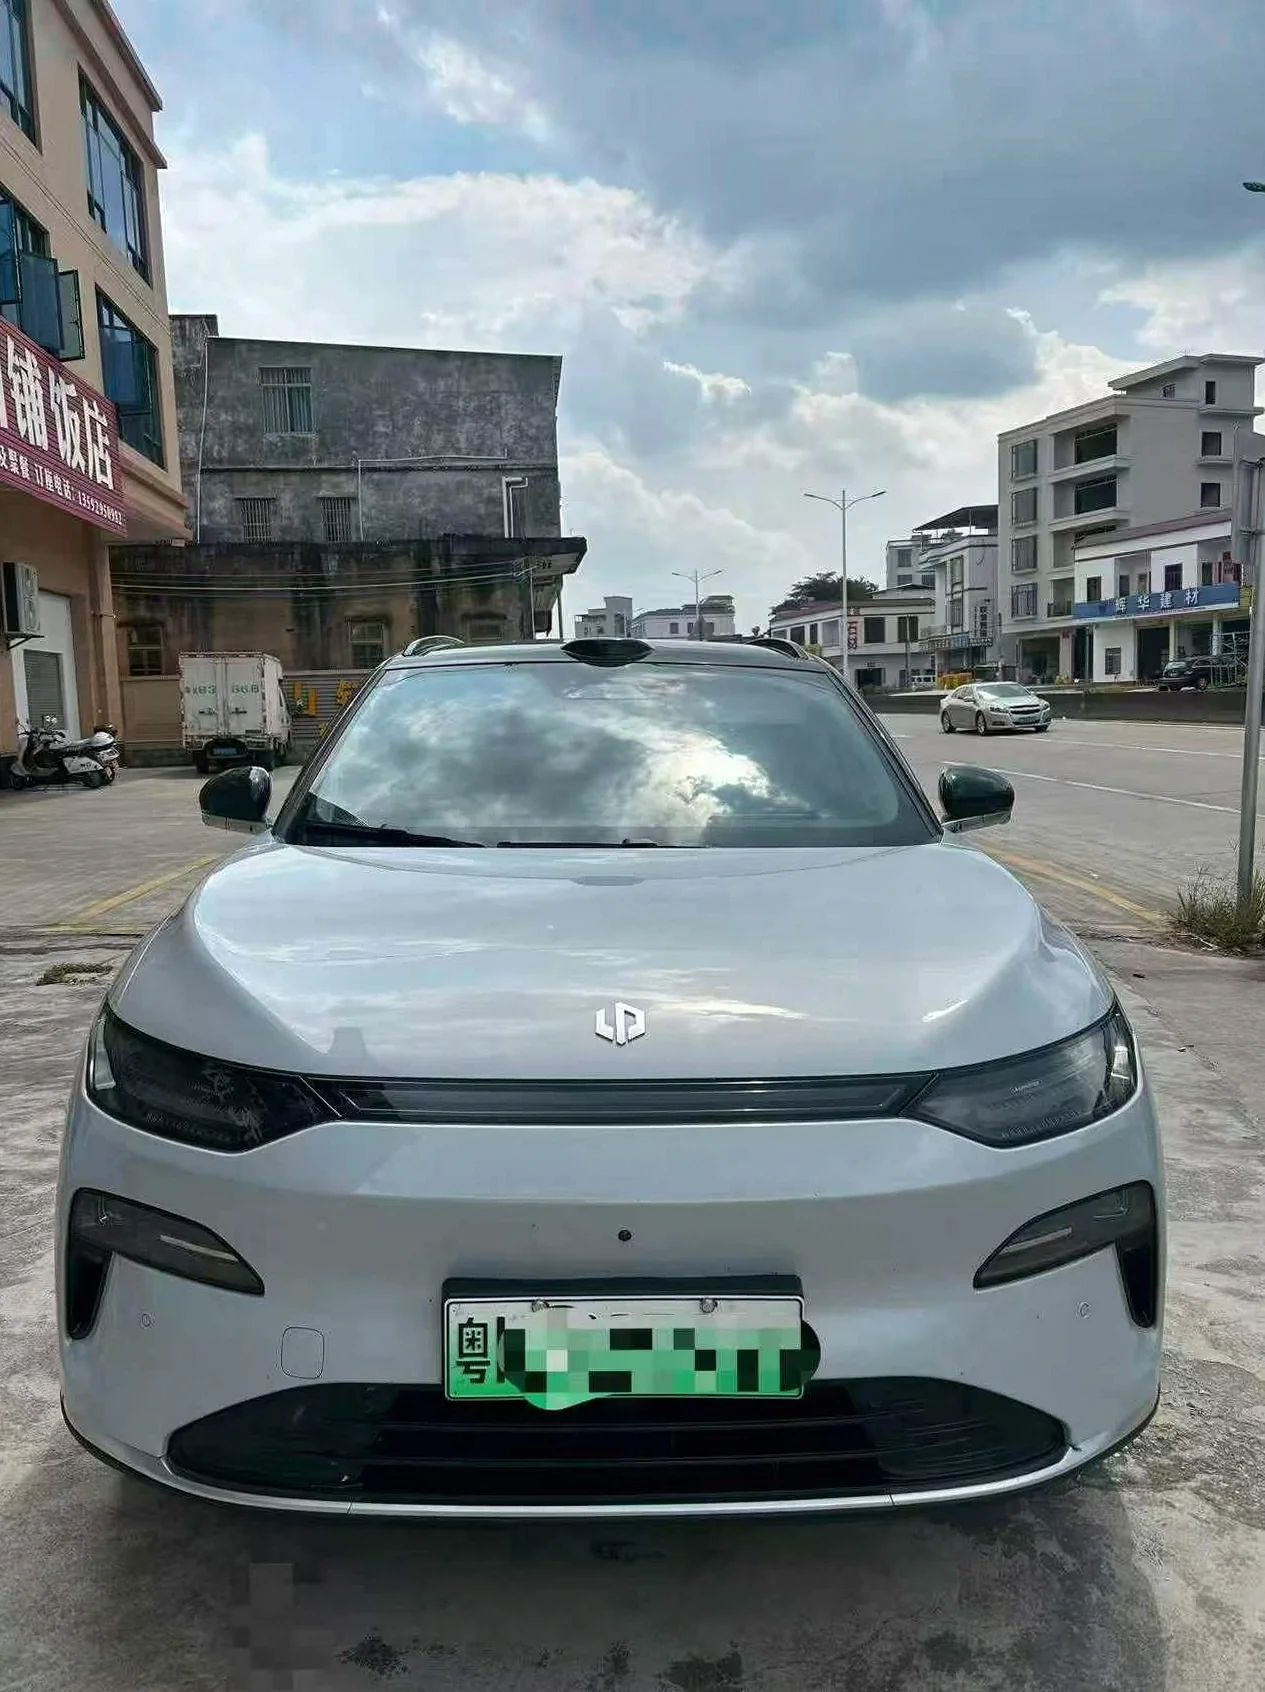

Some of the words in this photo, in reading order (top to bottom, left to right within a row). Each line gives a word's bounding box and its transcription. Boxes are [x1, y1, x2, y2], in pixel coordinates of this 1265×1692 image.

[0, 334, 114, 490] 铺饭店
[456, 1316, 491, 1384] 粤
